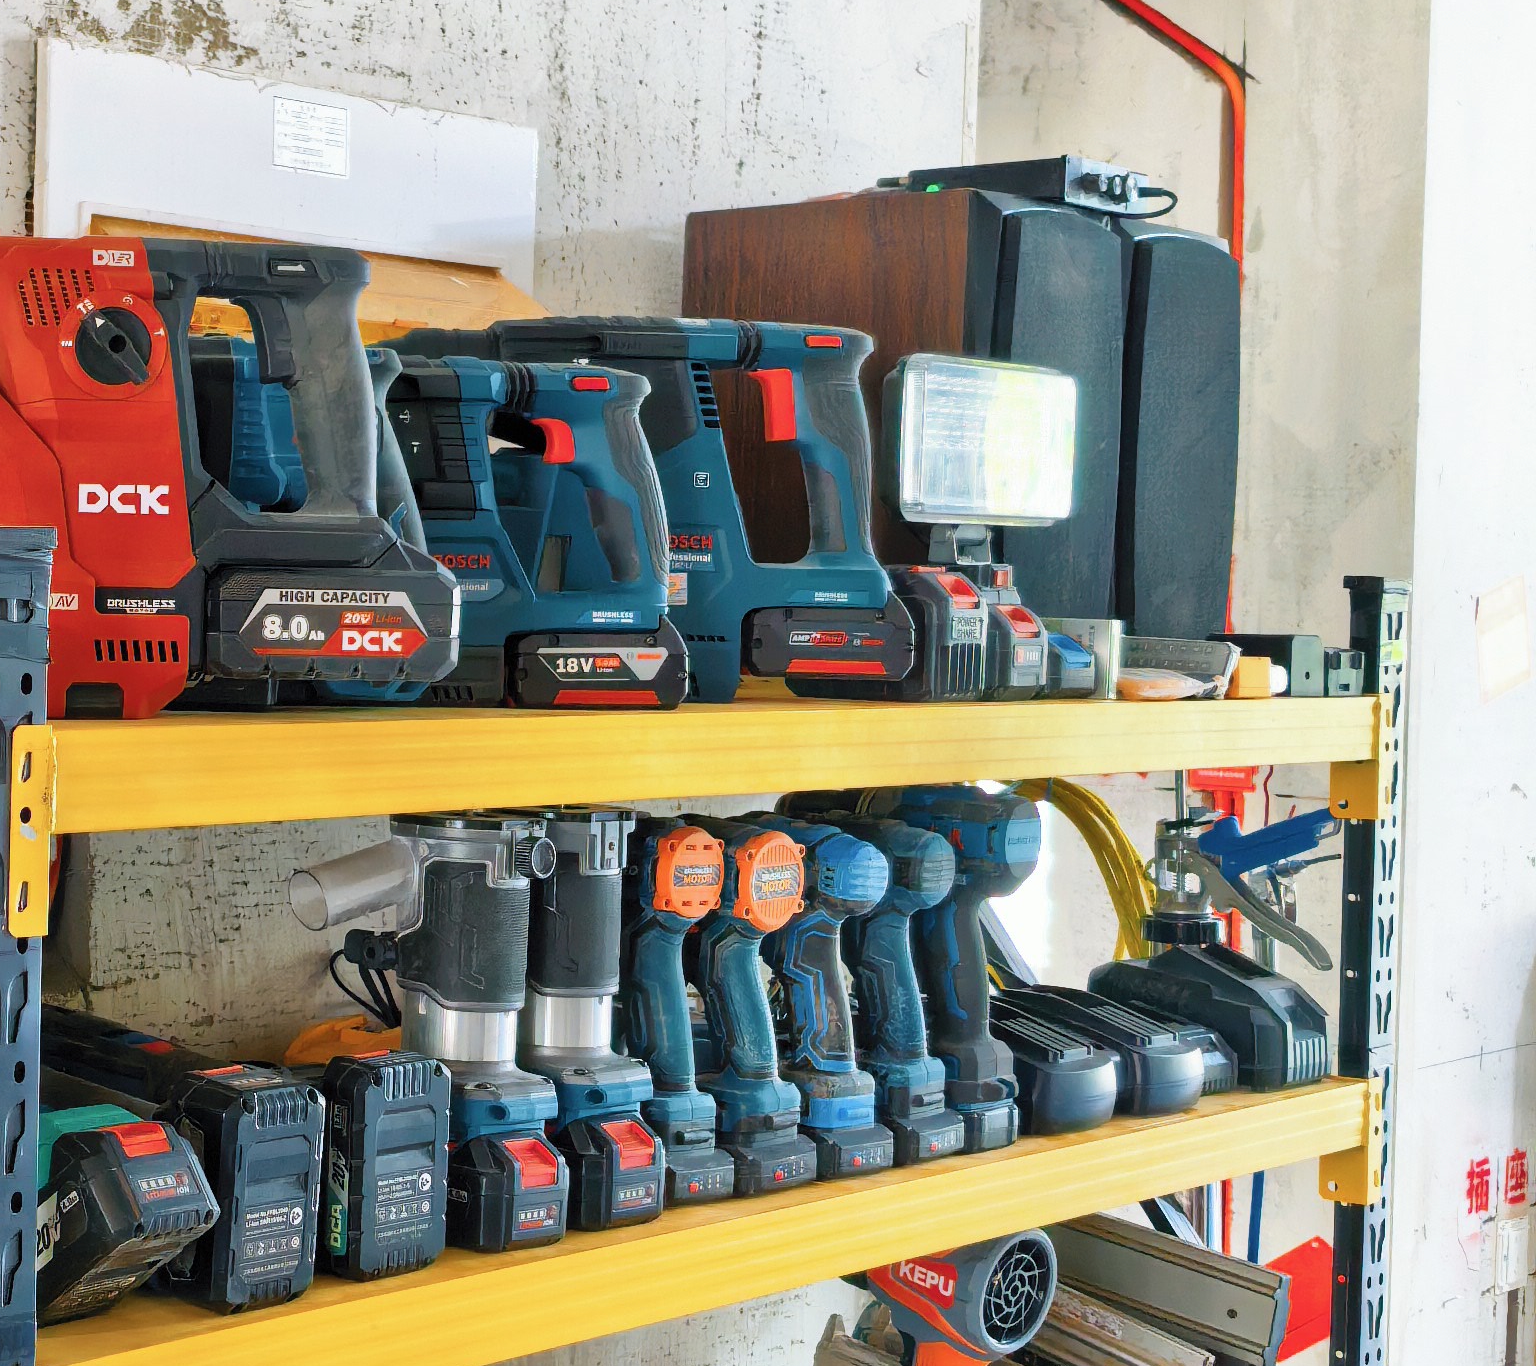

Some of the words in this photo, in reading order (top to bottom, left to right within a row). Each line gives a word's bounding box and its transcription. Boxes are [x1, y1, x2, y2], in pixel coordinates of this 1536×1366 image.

[78, 483, 169, 514] DCK
[668, 534, 713, 550] OSCH
[106, 598, 176, 608] BRUSHLESS
[279, 590, 315, 603] HIGH
[320, 591, 390, 604] CAPACITY
[262, 614, 311, 641] 8.0
[308, 630, 325, 641] Ah
[341, 631, 402, 652] DCK
[556, 657, 593, 673] 18V
[1466, 1147, 1528, 1214] 插座
[329, 1203, 343, 1248] DCA
[899, 1260, 954, 1297] KEPU
